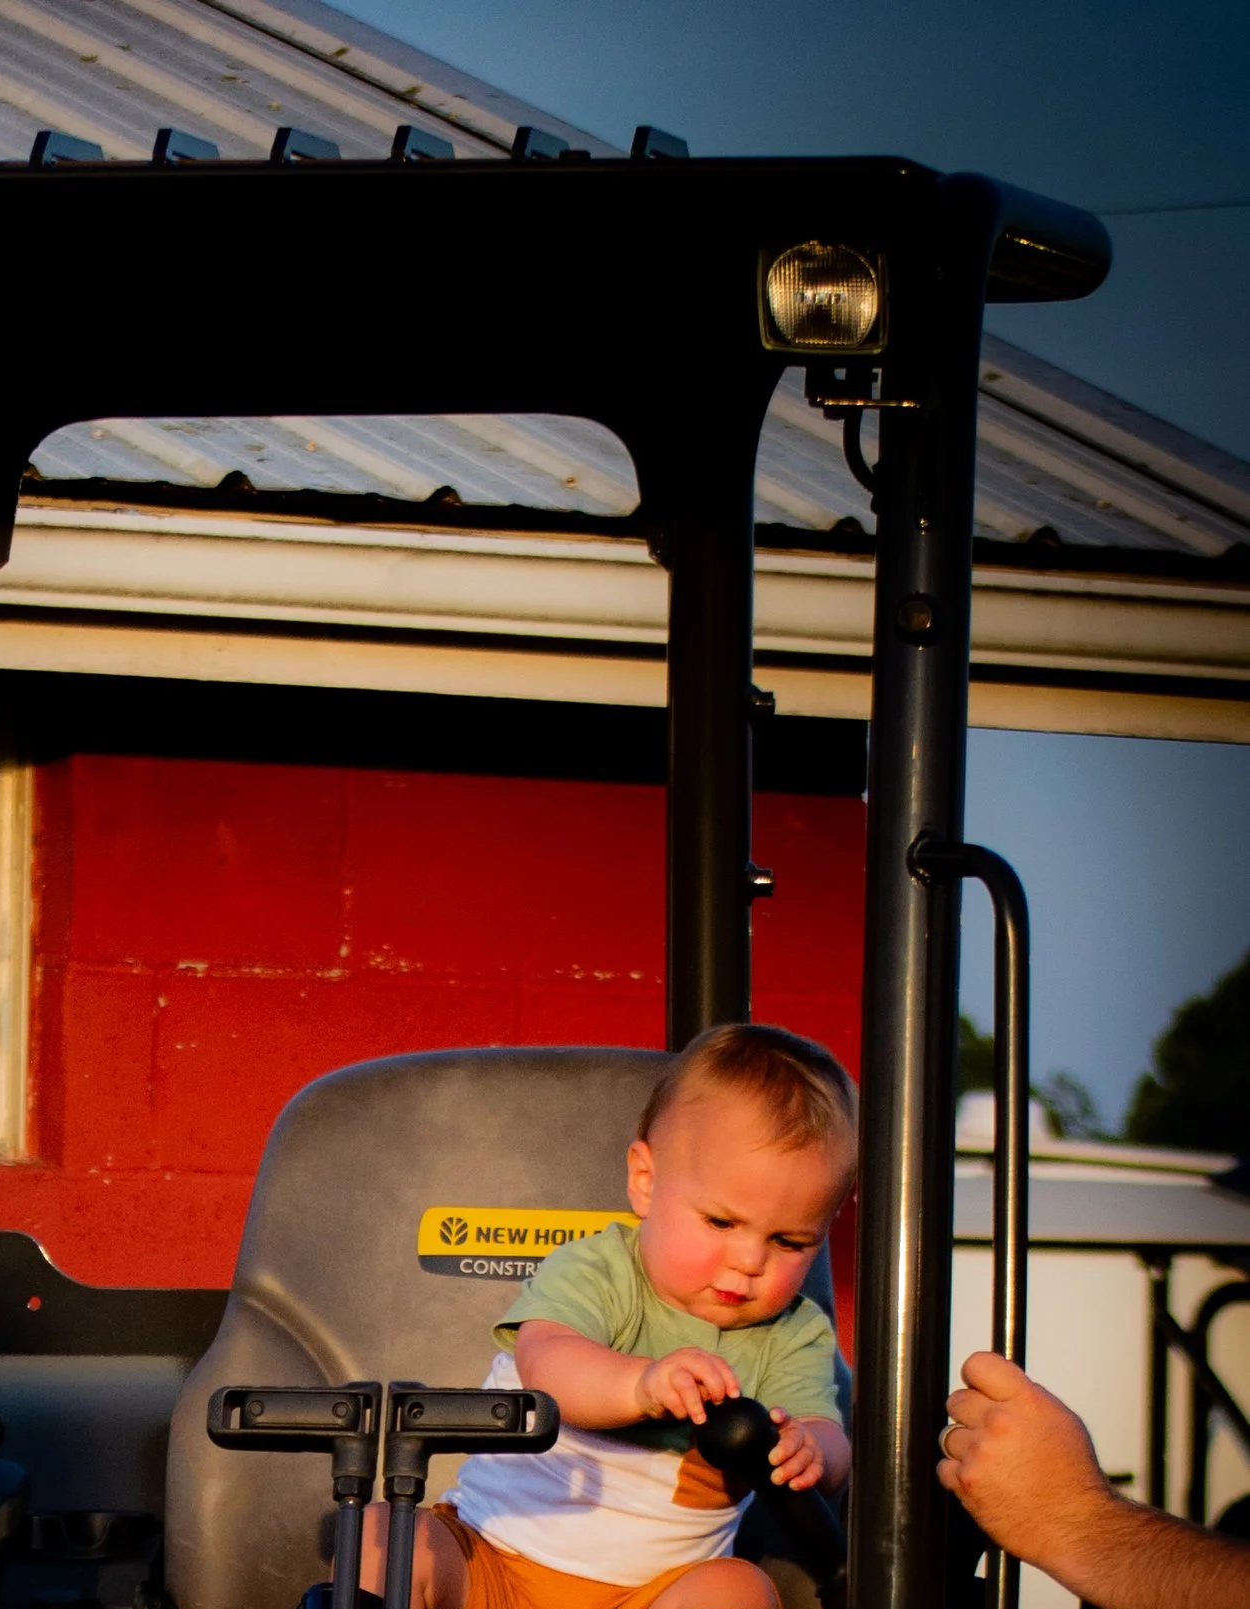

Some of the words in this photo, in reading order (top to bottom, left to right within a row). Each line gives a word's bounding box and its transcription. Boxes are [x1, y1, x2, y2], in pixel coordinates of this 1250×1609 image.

[476, 1227, 528, 1245] NEW
[534, 1229, 603, 1246] HOLL
[459, 1258, 541, 1277] CONSTR
